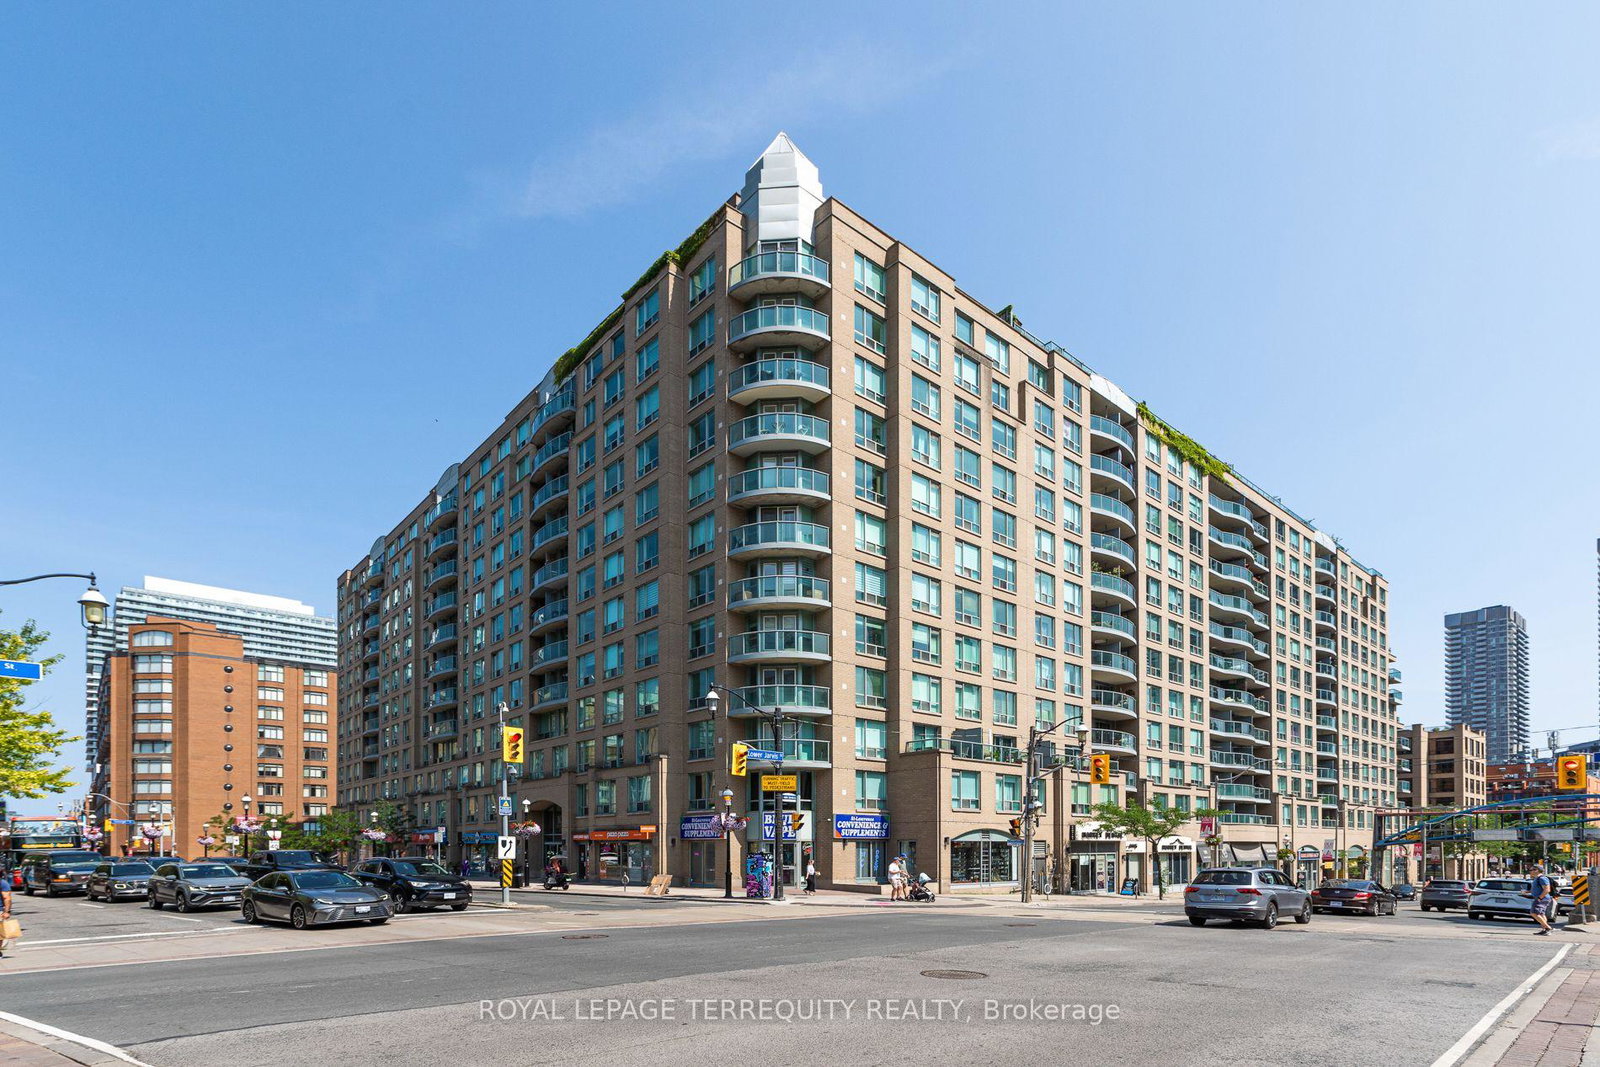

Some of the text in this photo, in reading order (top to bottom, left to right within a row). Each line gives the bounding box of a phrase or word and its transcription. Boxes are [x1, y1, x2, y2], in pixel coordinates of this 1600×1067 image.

[681, 822, 713, 830] CONVENIEN
[837, 821, 881, 829] CONVENIENCE
[840, 829, 886, 837] SUPPLEMENTS
